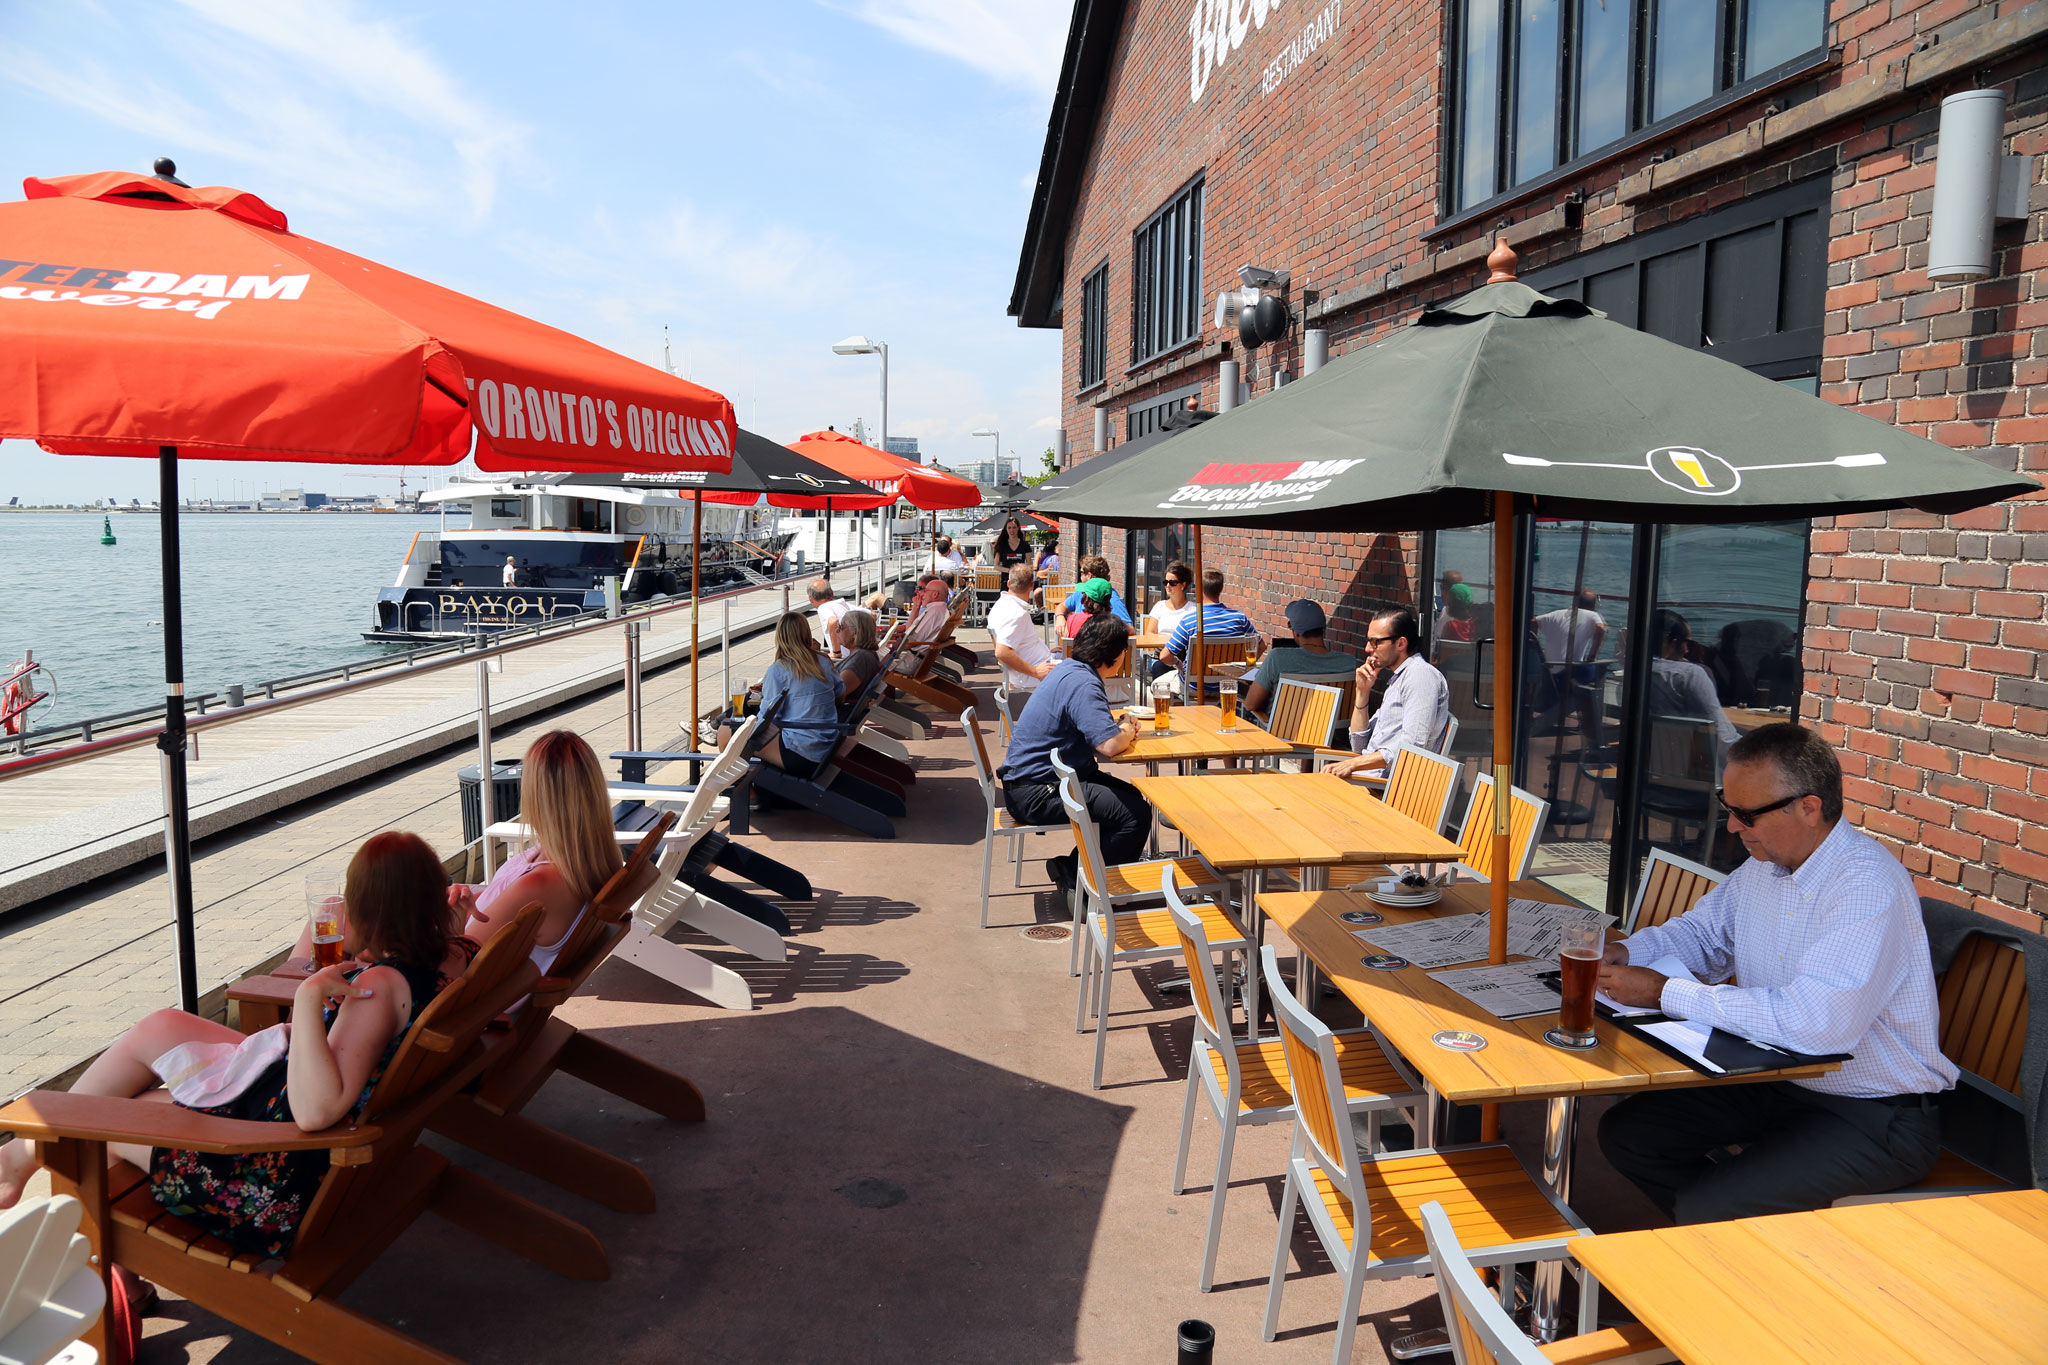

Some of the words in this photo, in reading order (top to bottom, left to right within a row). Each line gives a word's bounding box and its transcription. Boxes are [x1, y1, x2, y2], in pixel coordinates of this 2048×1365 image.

[1262, 0, 1343, 99] RESTAURANT
[1186, 458, 1367, 485] AMSTERDAM
[438, 594, 558, 616] BAYOU
